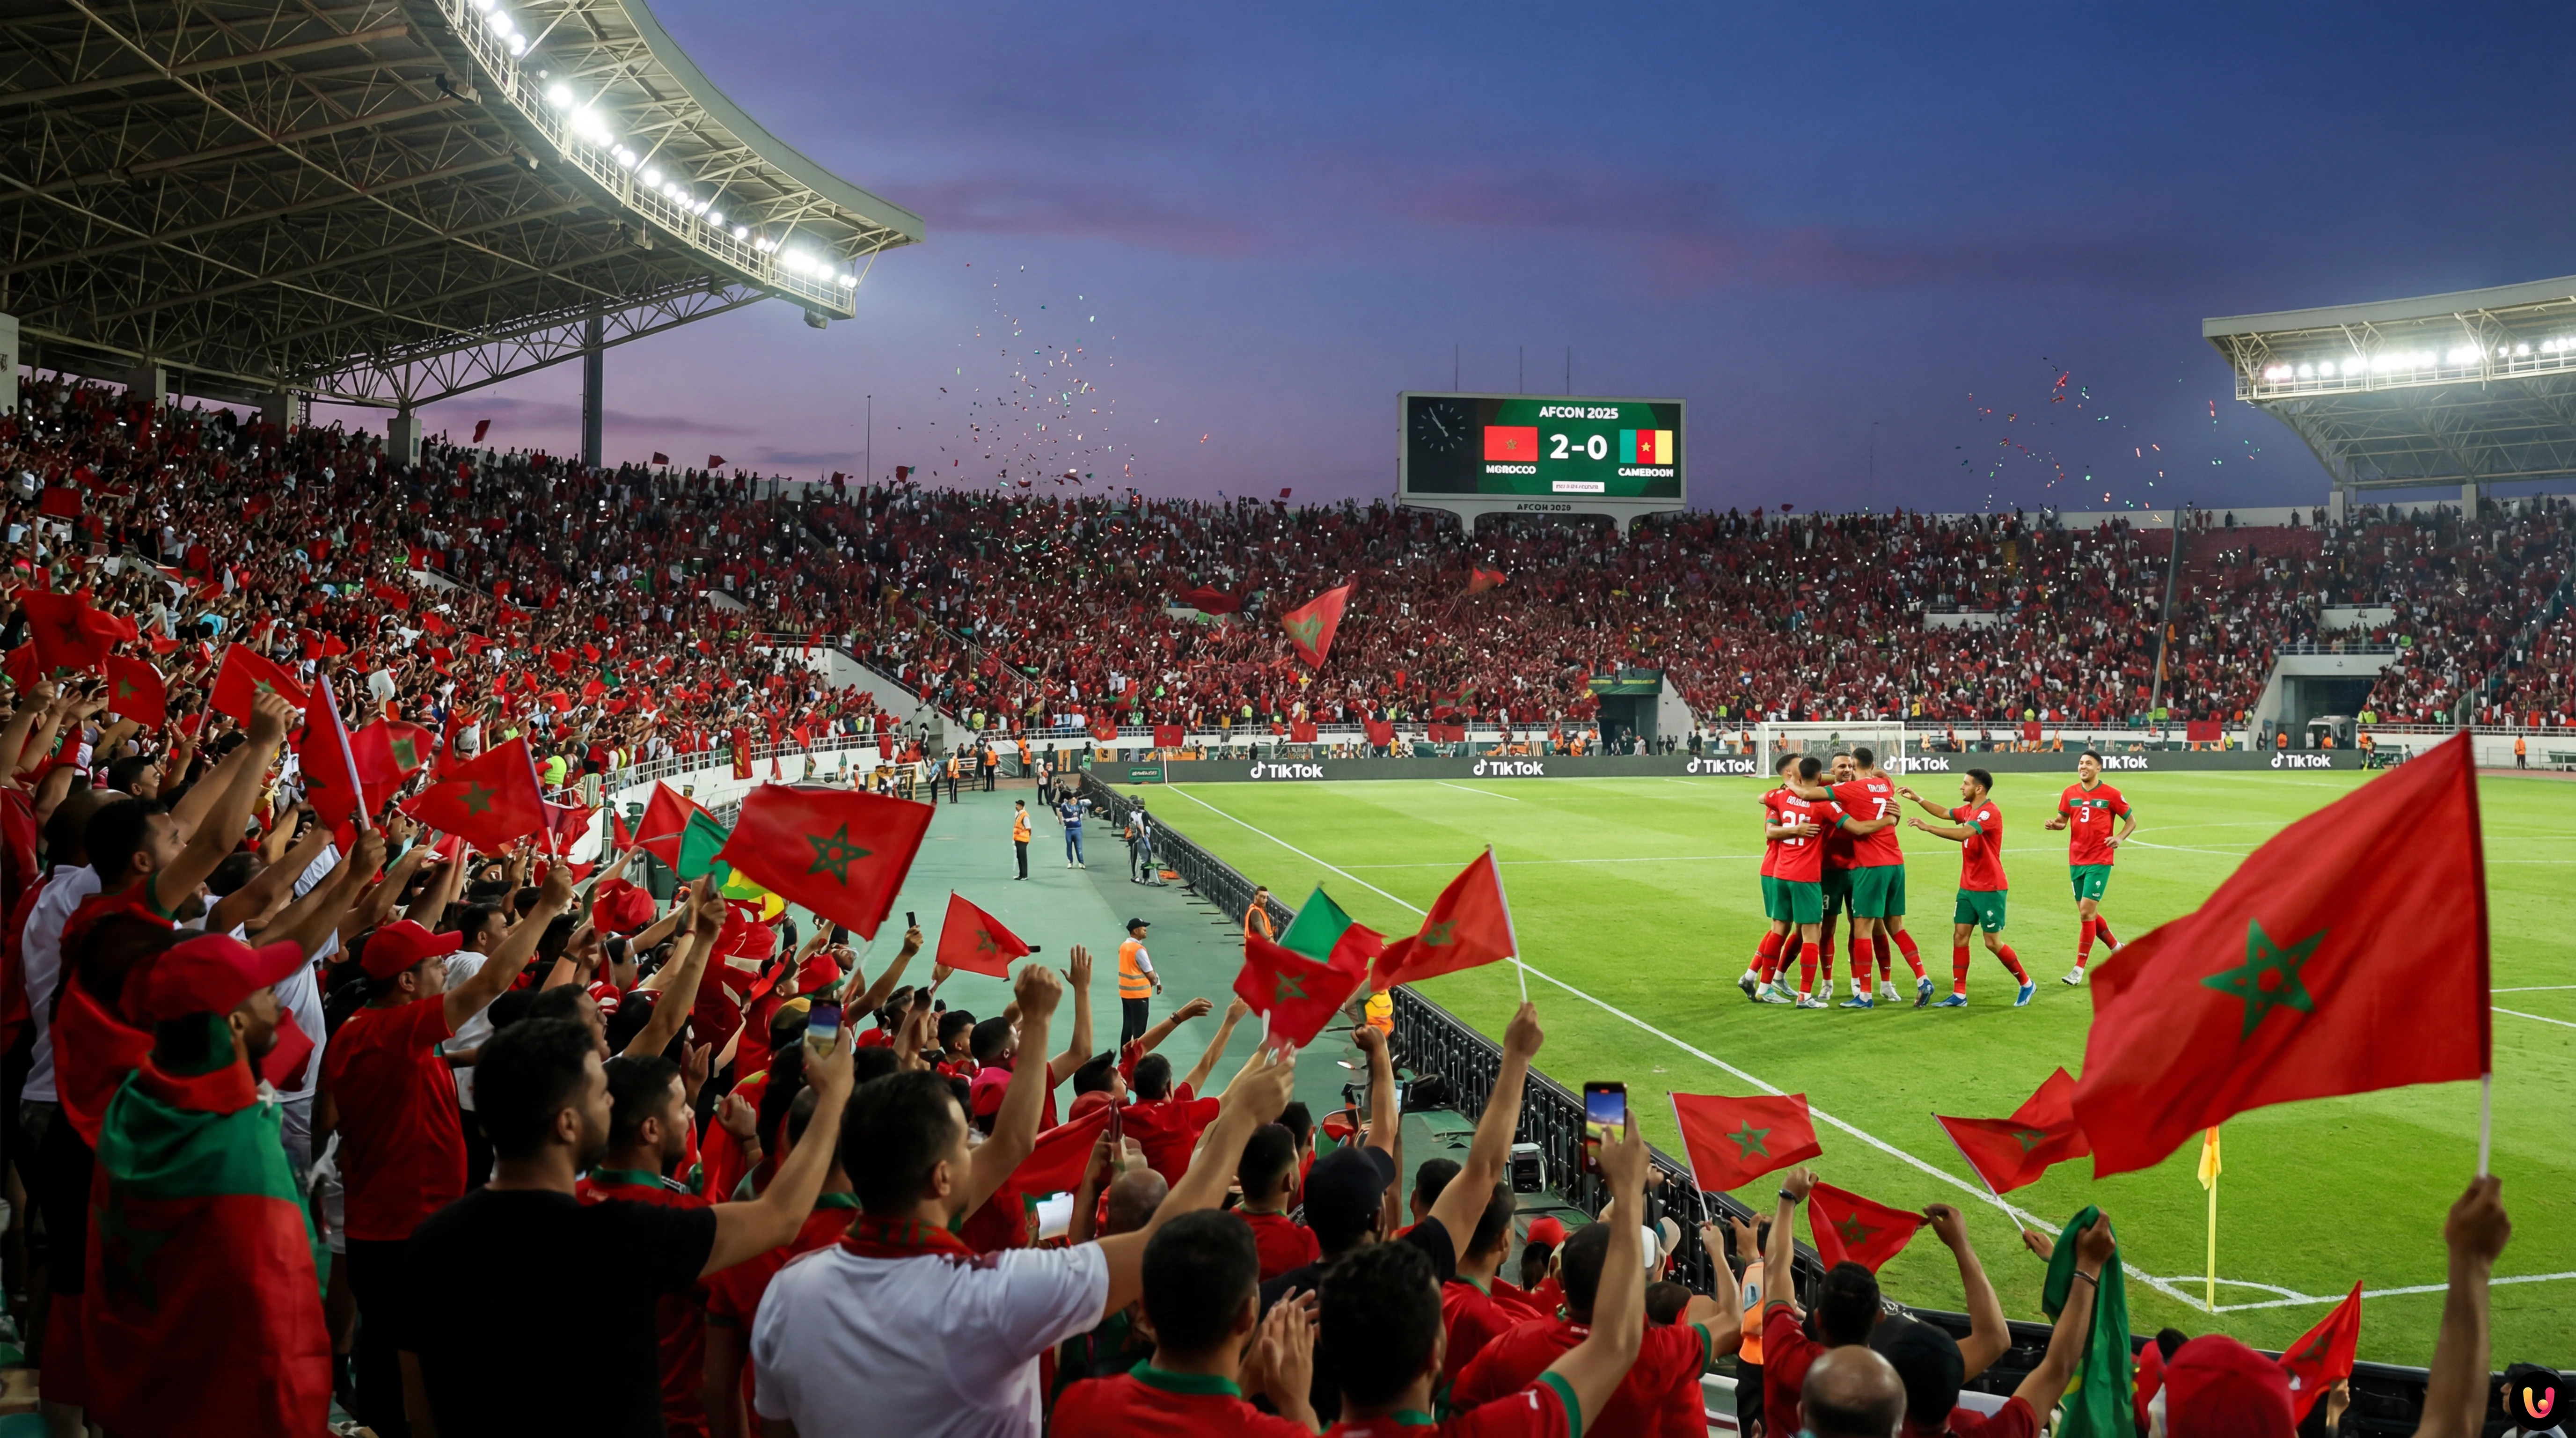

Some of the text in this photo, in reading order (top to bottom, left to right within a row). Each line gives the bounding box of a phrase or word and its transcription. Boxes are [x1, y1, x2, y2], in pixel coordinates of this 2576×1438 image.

[1539, 406, 1619, 419] AFCON 2025
[1550, 433, 1608, 460] 2-0
[1703, 759, 1756, 773] TikTok
[2100, 756, 2148, 769] TikTok
[2285, 754, 2331, 768] TikTok
[1267, 763, 1324, 778] TikTok
[1489, 761, 1544, 776] TikTok
[1873, 797, 1887, 820] 7
